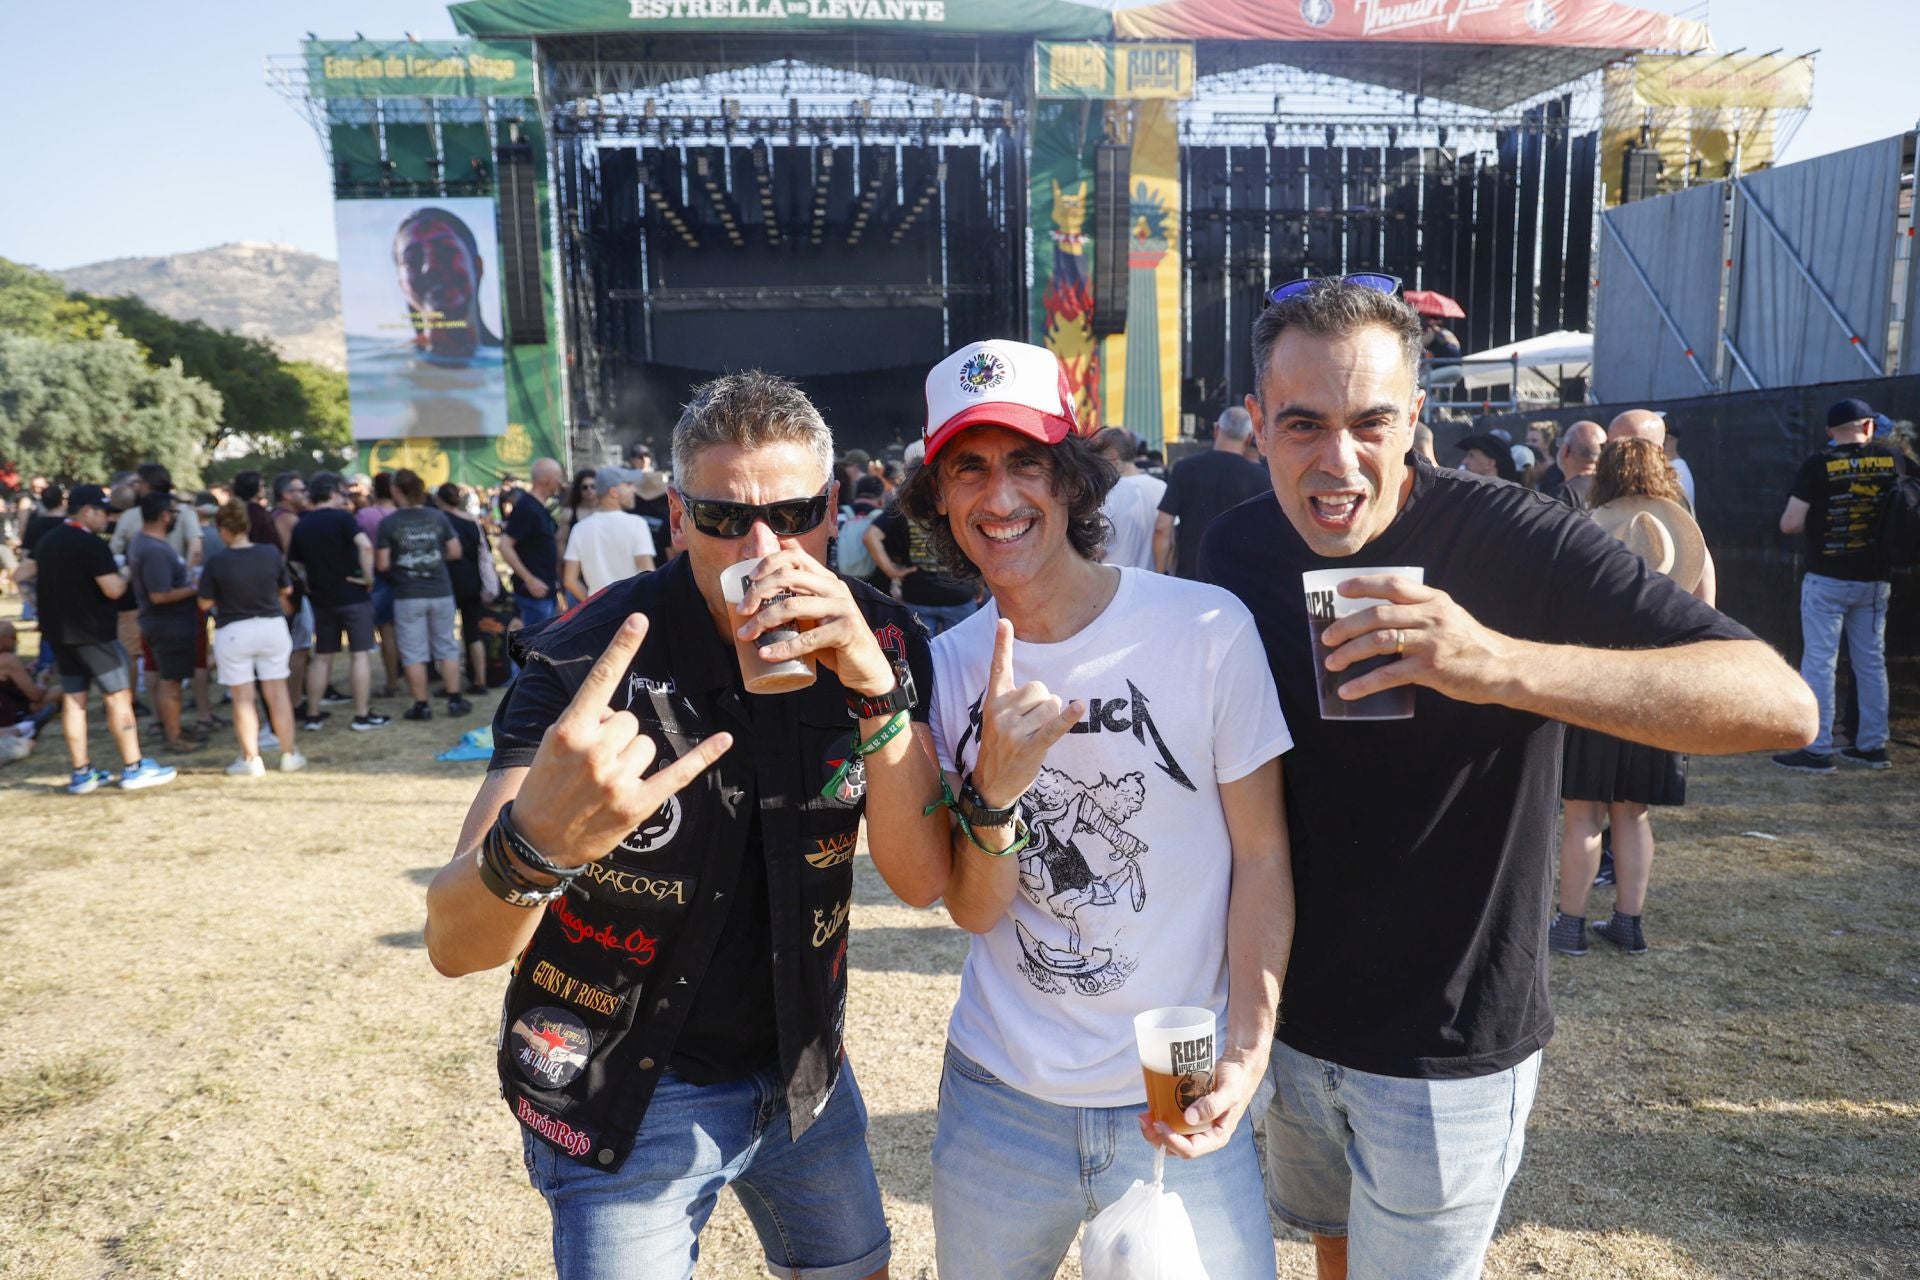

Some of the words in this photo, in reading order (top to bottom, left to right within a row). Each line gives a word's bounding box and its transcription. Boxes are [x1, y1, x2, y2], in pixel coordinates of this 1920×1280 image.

[629, 0, 787, 19] ESTRELLA
[808, 0, 945, 21] LEVANTE
[1128, 49, 1180, 91] ROCK
[959, 353, 1004, 375] UNLIMITED
[960, 380, 979, 393] LOVE
[984, 374, 1005, 390] TOUR
[585, 861, 687, 905] RATOGA
[594, 925, 625, 950] de
[532, 960, 565, 994] GUNS
[559, 977, 580, 1000] N'
[574, 982, 619, 1016] ROSES
[519, 1047, 564, 1080] METALLICA
[1169, 1034, 1213, 1077] ROCK
[553, 1118, 591, 1156] Rojo
